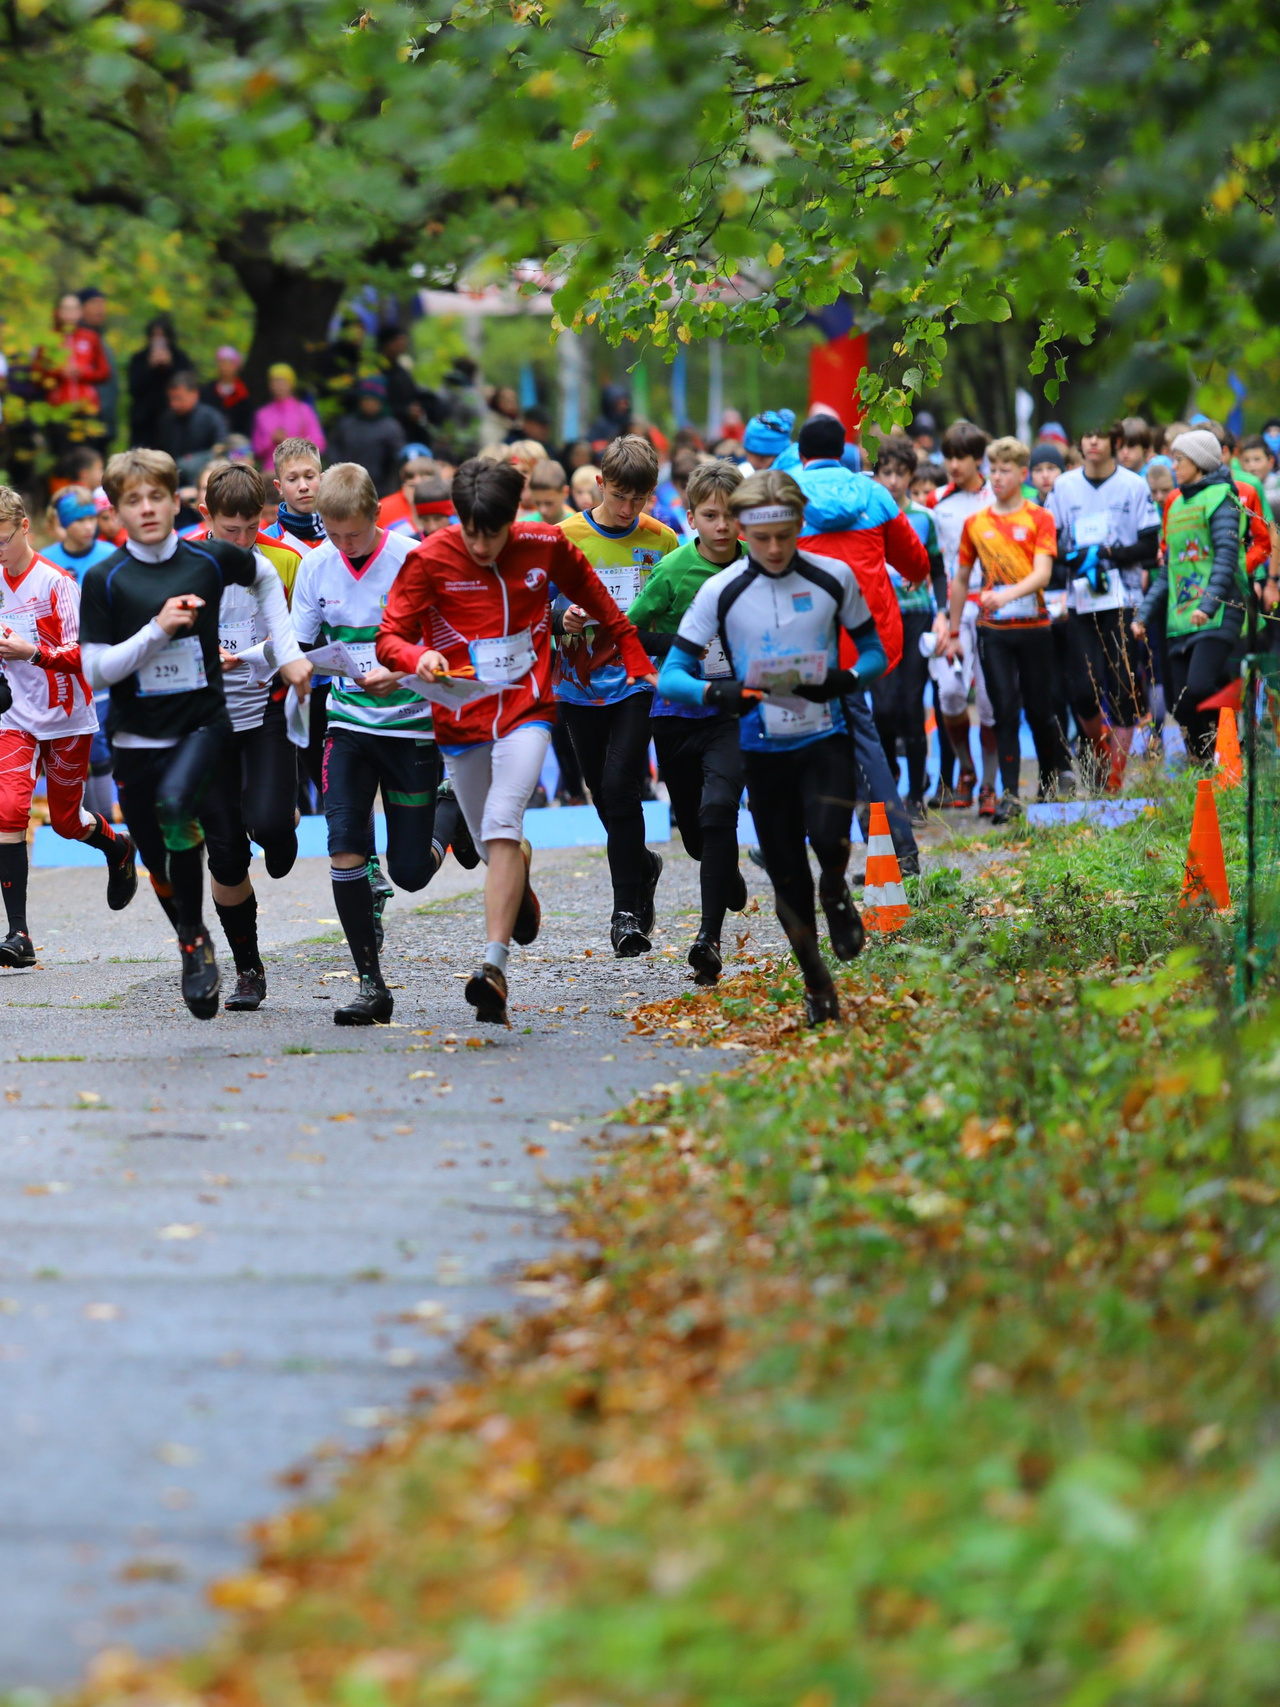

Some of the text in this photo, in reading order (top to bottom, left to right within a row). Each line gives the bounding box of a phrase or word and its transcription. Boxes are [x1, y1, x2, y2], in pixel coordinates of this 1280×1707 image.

[604, 585, 621, 596] 37
[356, 661, 372, 673] 27
[494, 654, 515, 668] 225
[155, 664, 179, 678] 229
[54, 672, 69, 703] think
